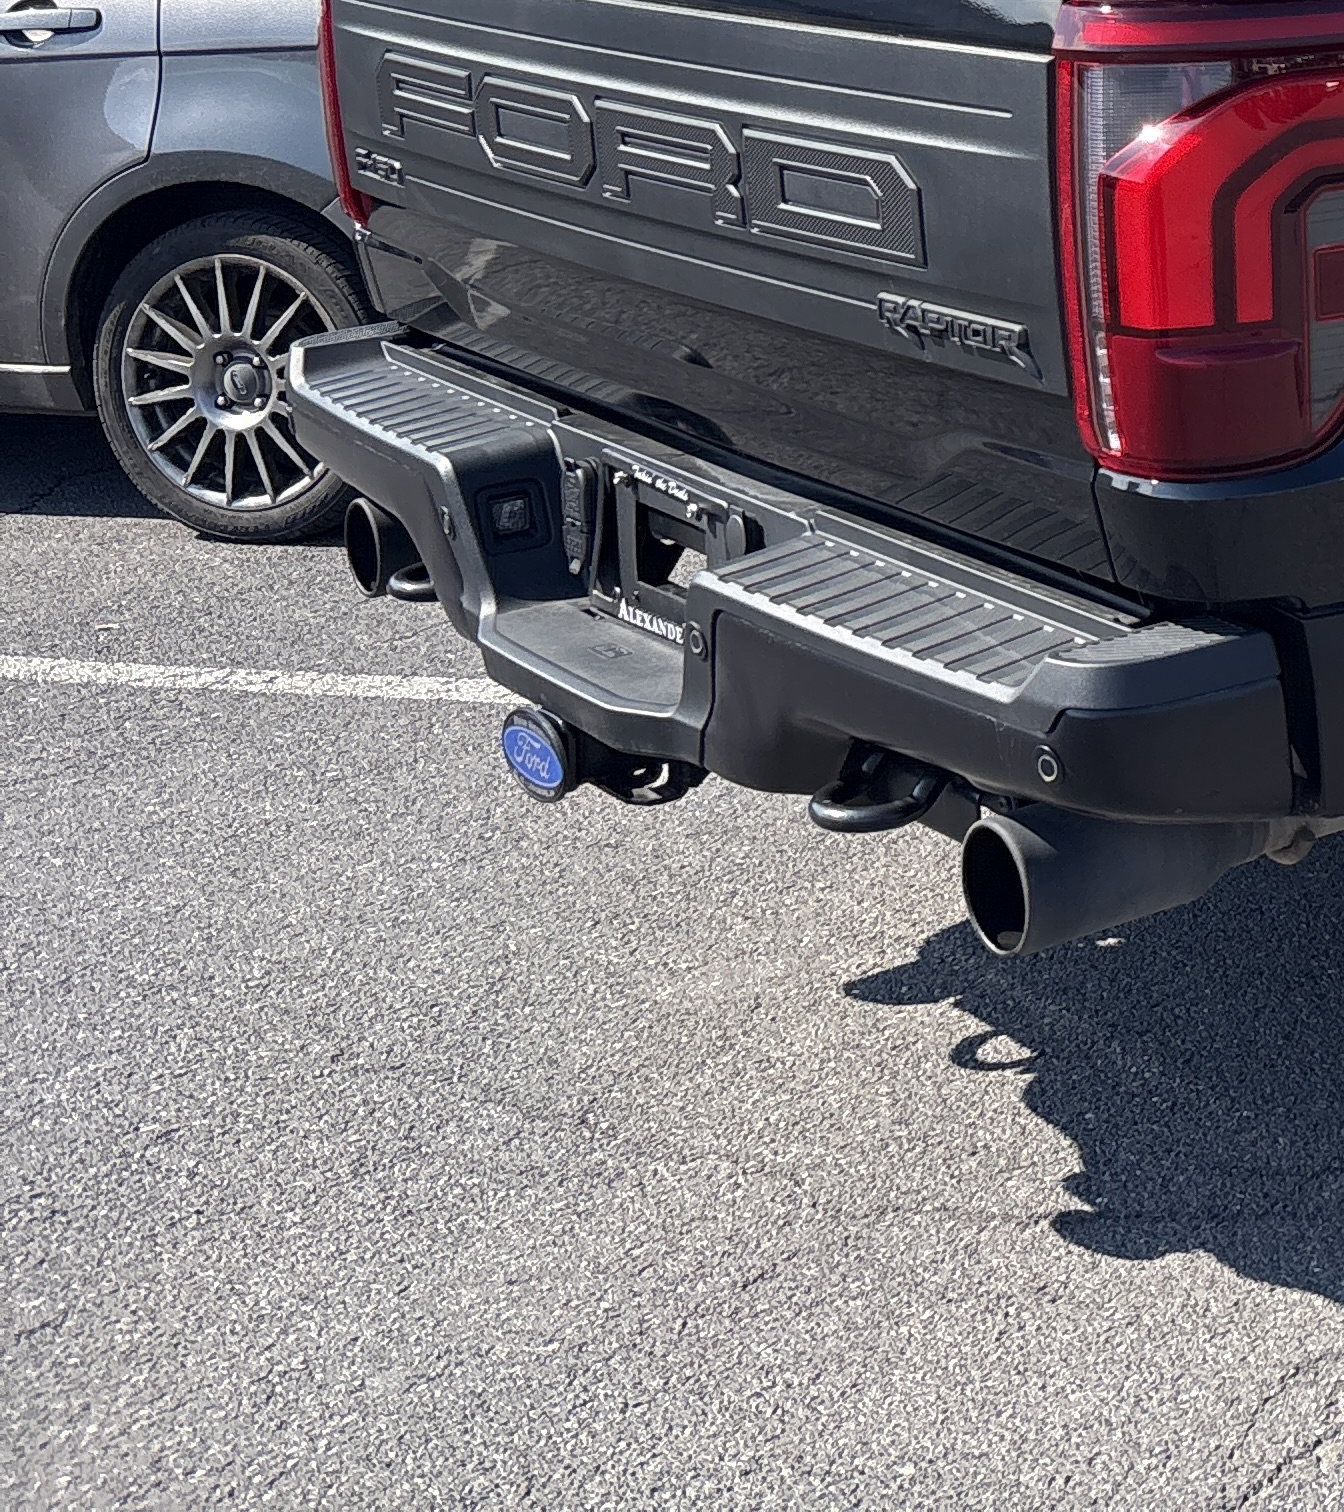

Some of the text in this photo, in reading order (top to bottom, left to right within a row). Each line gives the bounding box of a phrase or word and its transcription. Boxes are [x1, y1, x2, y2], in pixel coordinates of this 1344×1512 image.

[375, 48, 927, 270] FORD
[876, 291, 1032, 370] RAPTOR
[618, 598, 685, 644] ALEXANDE
[514, 732, 550, 779] Ford
